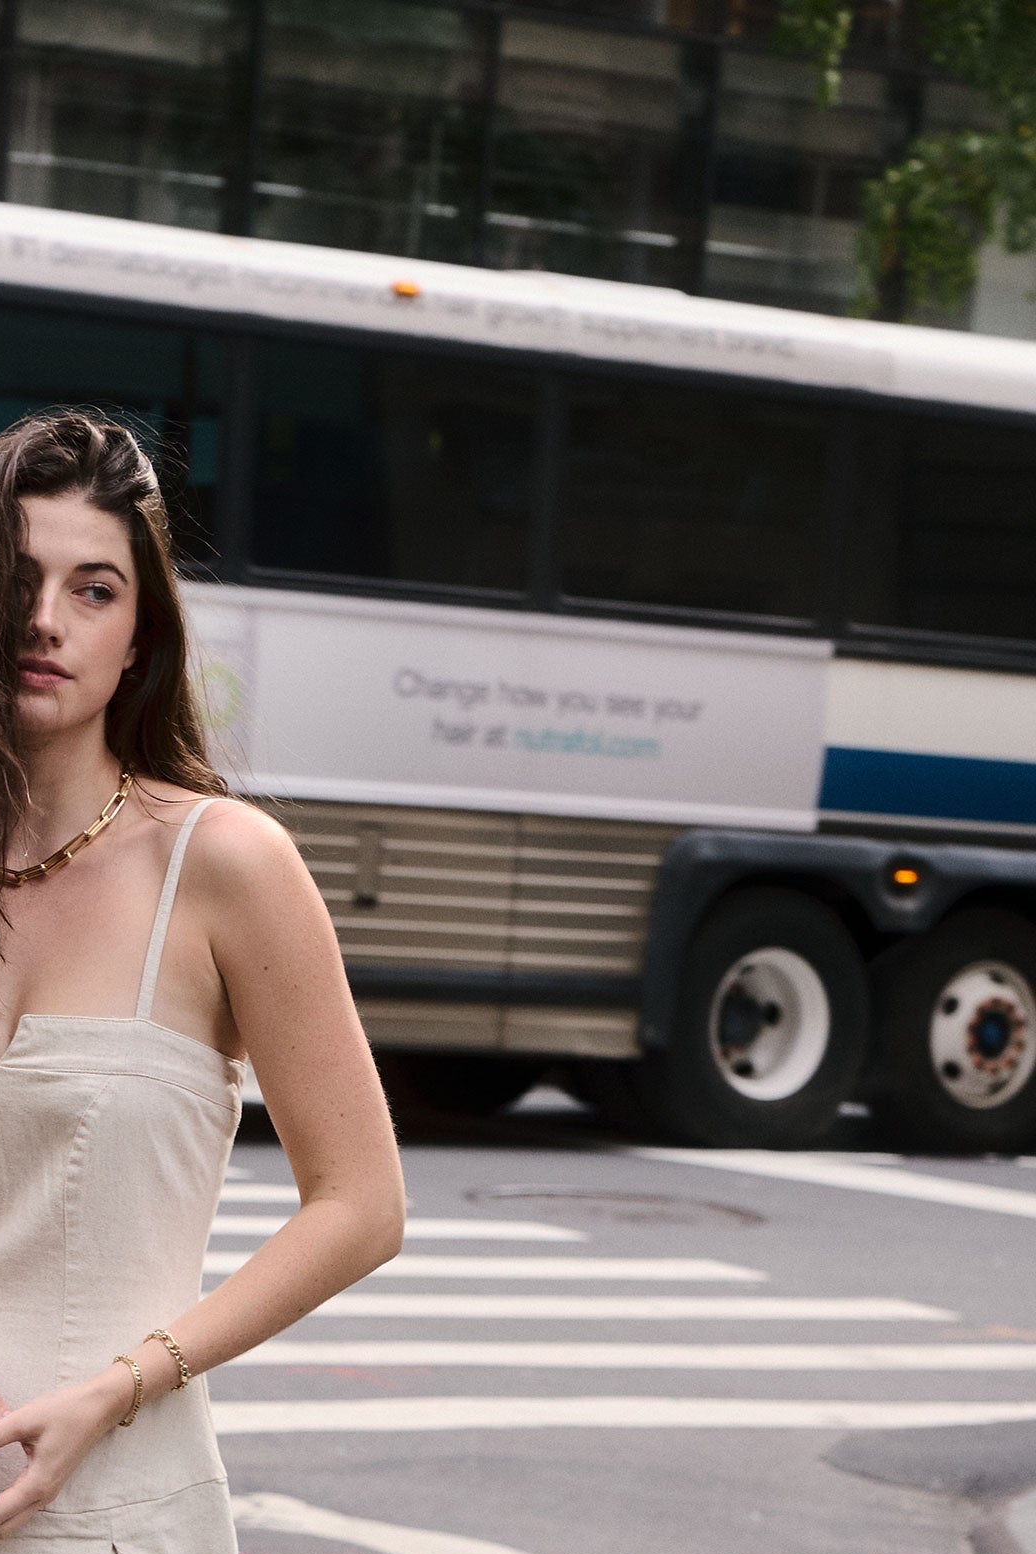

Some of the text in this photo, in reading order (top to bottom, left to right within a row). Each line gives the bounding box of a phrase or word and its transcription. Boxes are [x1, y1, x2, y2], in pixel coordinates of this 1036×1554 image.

[391, 666, 705, 723] Change how you see your
[431, 718, 478, 745] hair
[483, 724, 507, 747] at
